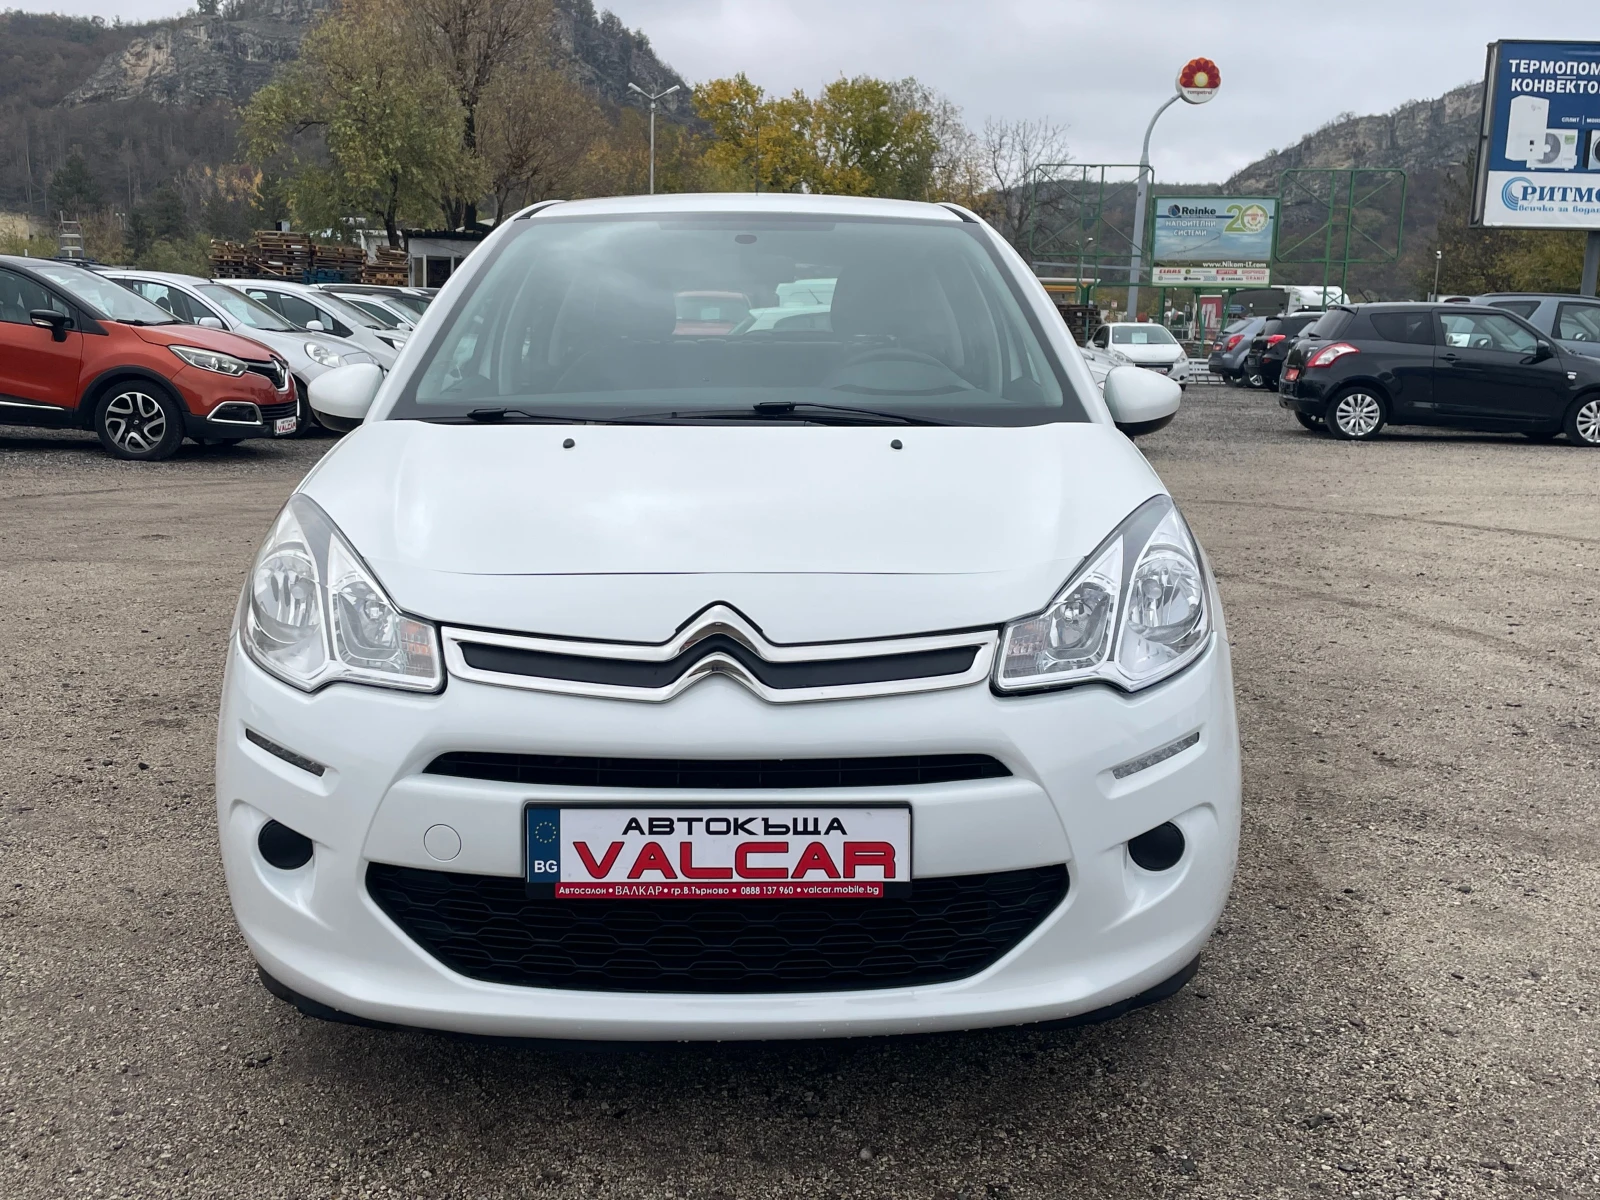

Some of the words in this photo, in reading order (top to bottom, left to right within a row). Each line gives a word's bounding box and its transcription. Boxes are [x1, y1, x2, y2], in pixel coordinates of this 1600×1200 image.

[1509, 59, 1600, 76] ТЕРМОПОМ
[1511, 78, 1600, 94] КОНВЕКТО
[1181, 206, 1216, 215] Reinke
[622, 817, 848, 835] АВТОКЪЩА
[534, 860, 558, 873] BG
[572, 841, 896, 879] VALCAR
[558, 886, 607, 895] Автосалон
[615, 885, 662, 896] ВАЛКАР
[740, 886, 763, 895] 0888
[763, 886, 777, 895] 137
[779, 886, 794, 895] 960
[803, 885, 880, 896] valcar.mobile.bg
